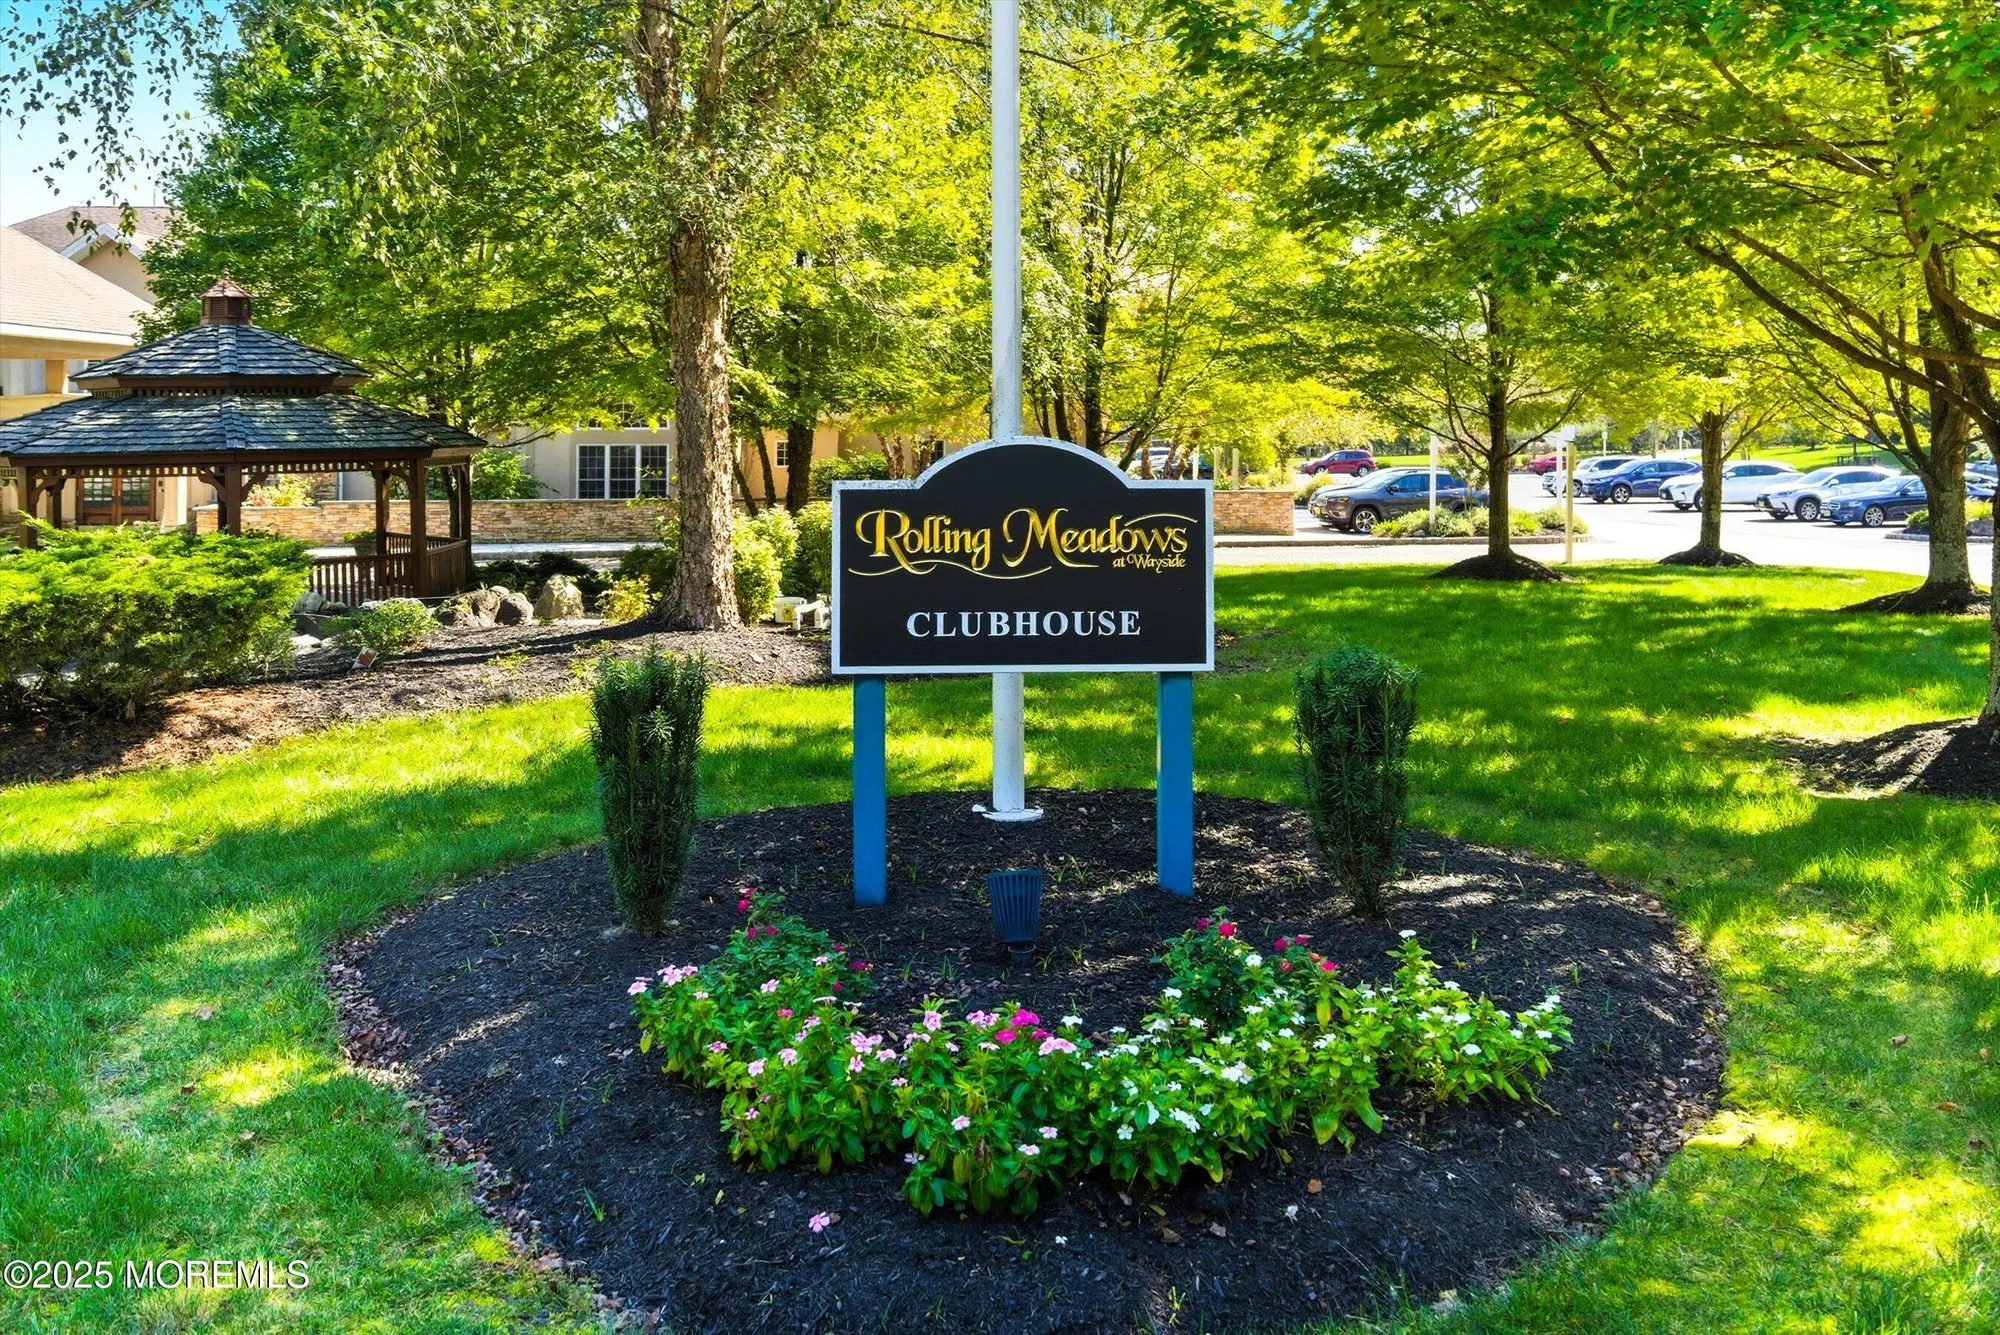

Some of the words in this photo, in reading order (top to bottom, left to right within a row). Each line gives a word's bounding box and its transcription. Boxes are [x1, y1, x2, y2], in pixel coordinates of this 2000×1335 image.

[854, 508, 991, 575] Rolling
[1001, 508, 1189, 568] Meadows
[1112, 557, 1125, 568] at
[1126, 553, 1187, 574] Wayside
[906, 610, 1141, 638] CLUBHOUSE
